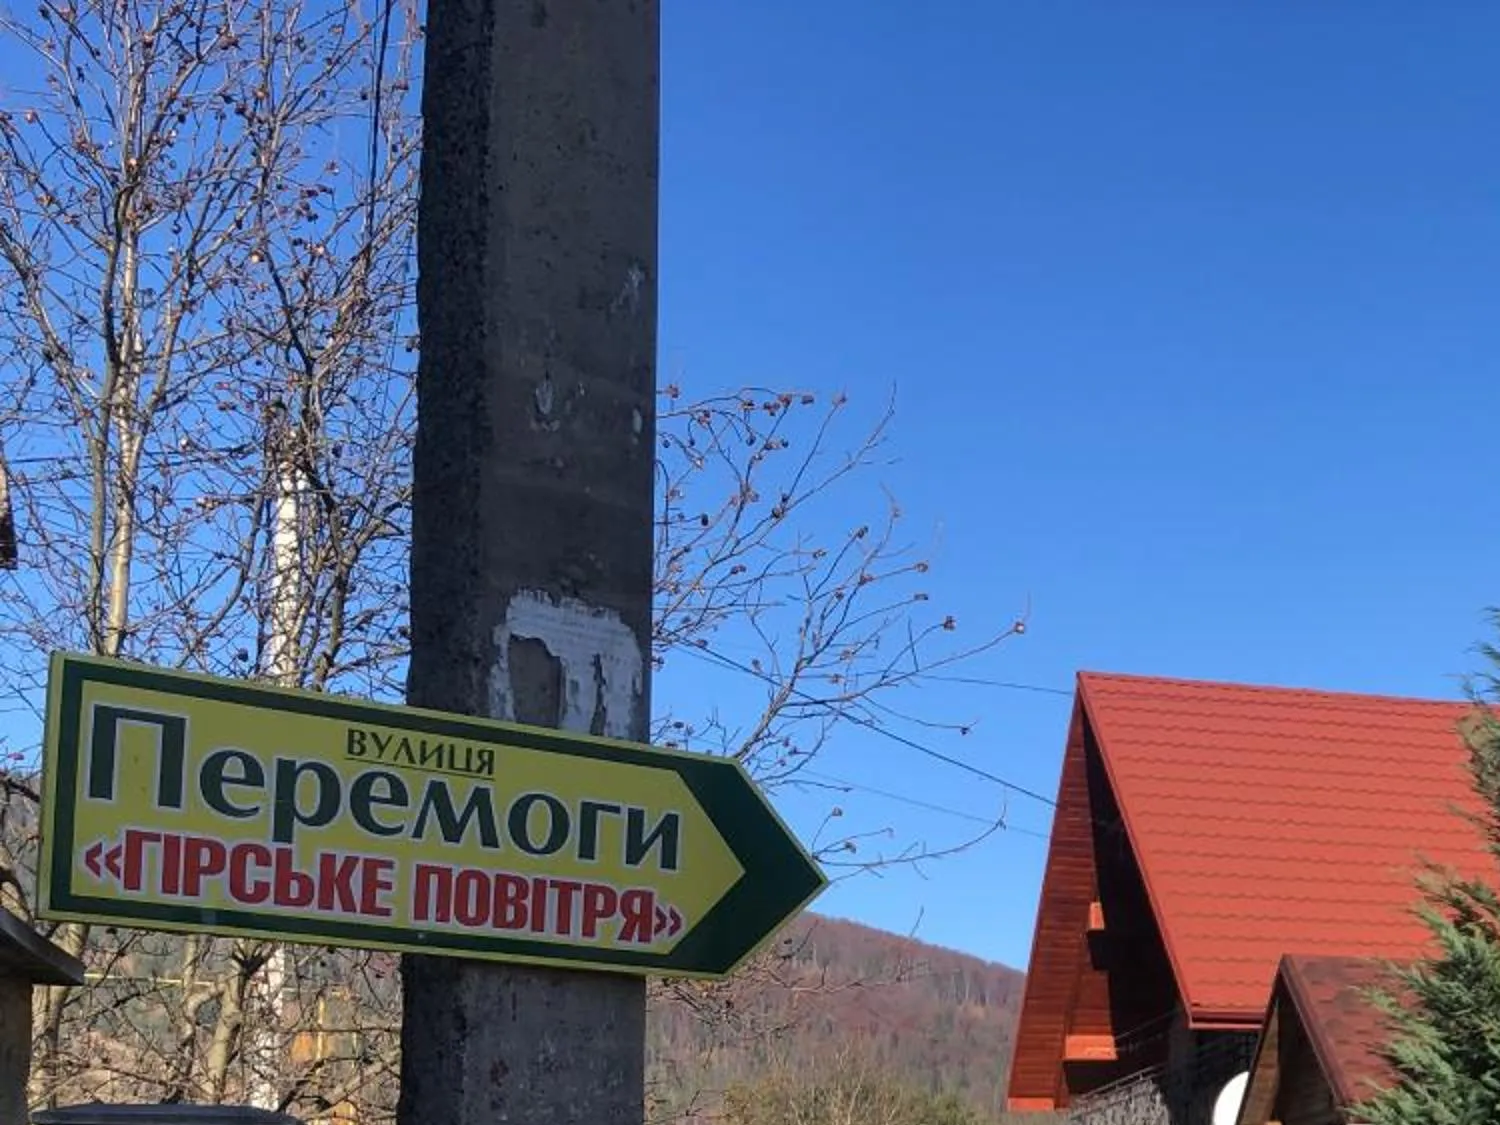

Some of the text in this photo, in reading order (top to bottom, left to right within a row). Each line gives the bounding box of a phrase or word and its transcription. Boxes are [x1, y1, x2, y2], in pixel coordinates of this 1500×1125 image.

[88, 703, 680, 871] Перемоги
[347, 728, 496, 775] ВУЛИЦЯ
[84, 829, 682, 944] «ГІРСЬКЕ ПОВІТРЯ»
